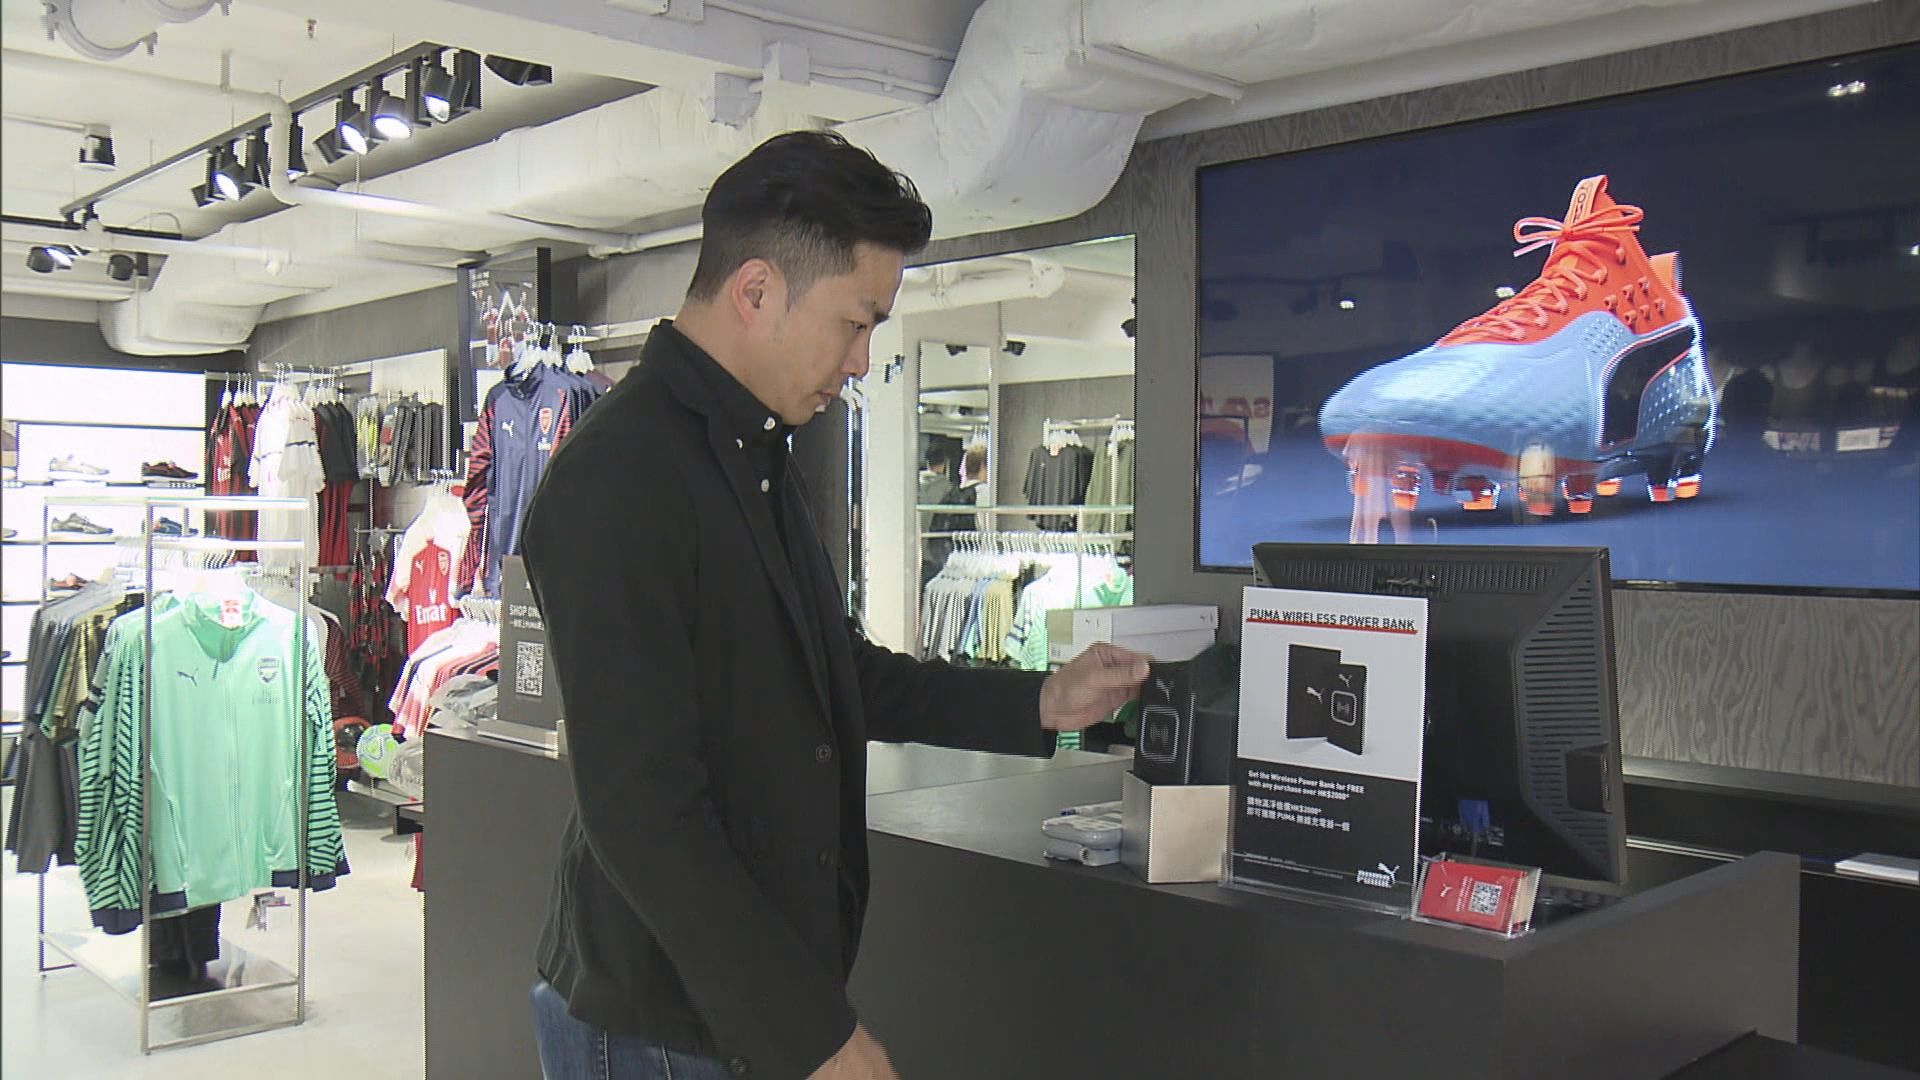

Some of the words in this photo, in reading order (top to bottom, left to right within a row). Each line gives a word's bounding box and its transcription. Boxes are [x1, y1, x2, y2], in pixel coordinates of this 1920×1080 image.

[509, 604, 527, 617] SHOP
[1250, 608, 1280, 620] PUMA
[1282, 610, 1337, 625] WIRELESS
[1339, 614, 1379, 628] POWER
[1383, 618, 1415, 631] BANK
[1248, 770, 1259, 778] Get
[1259, 771, 1270, 780] the
[1270, 773, 1298, 784] Wireless
[1298, 777, 1318, 786] Power
[1319, 780, 1335, 789] Bank
[1336, 782, 1346, 791] for
[1346, 784, 1365, 794] FREE
[1262, 782, 1273, 791] any
[1273, 784, 1302, 794] purchase
[1302, 788, 1317, 796] over
[1277, 811, 1296, 822] PUMA
